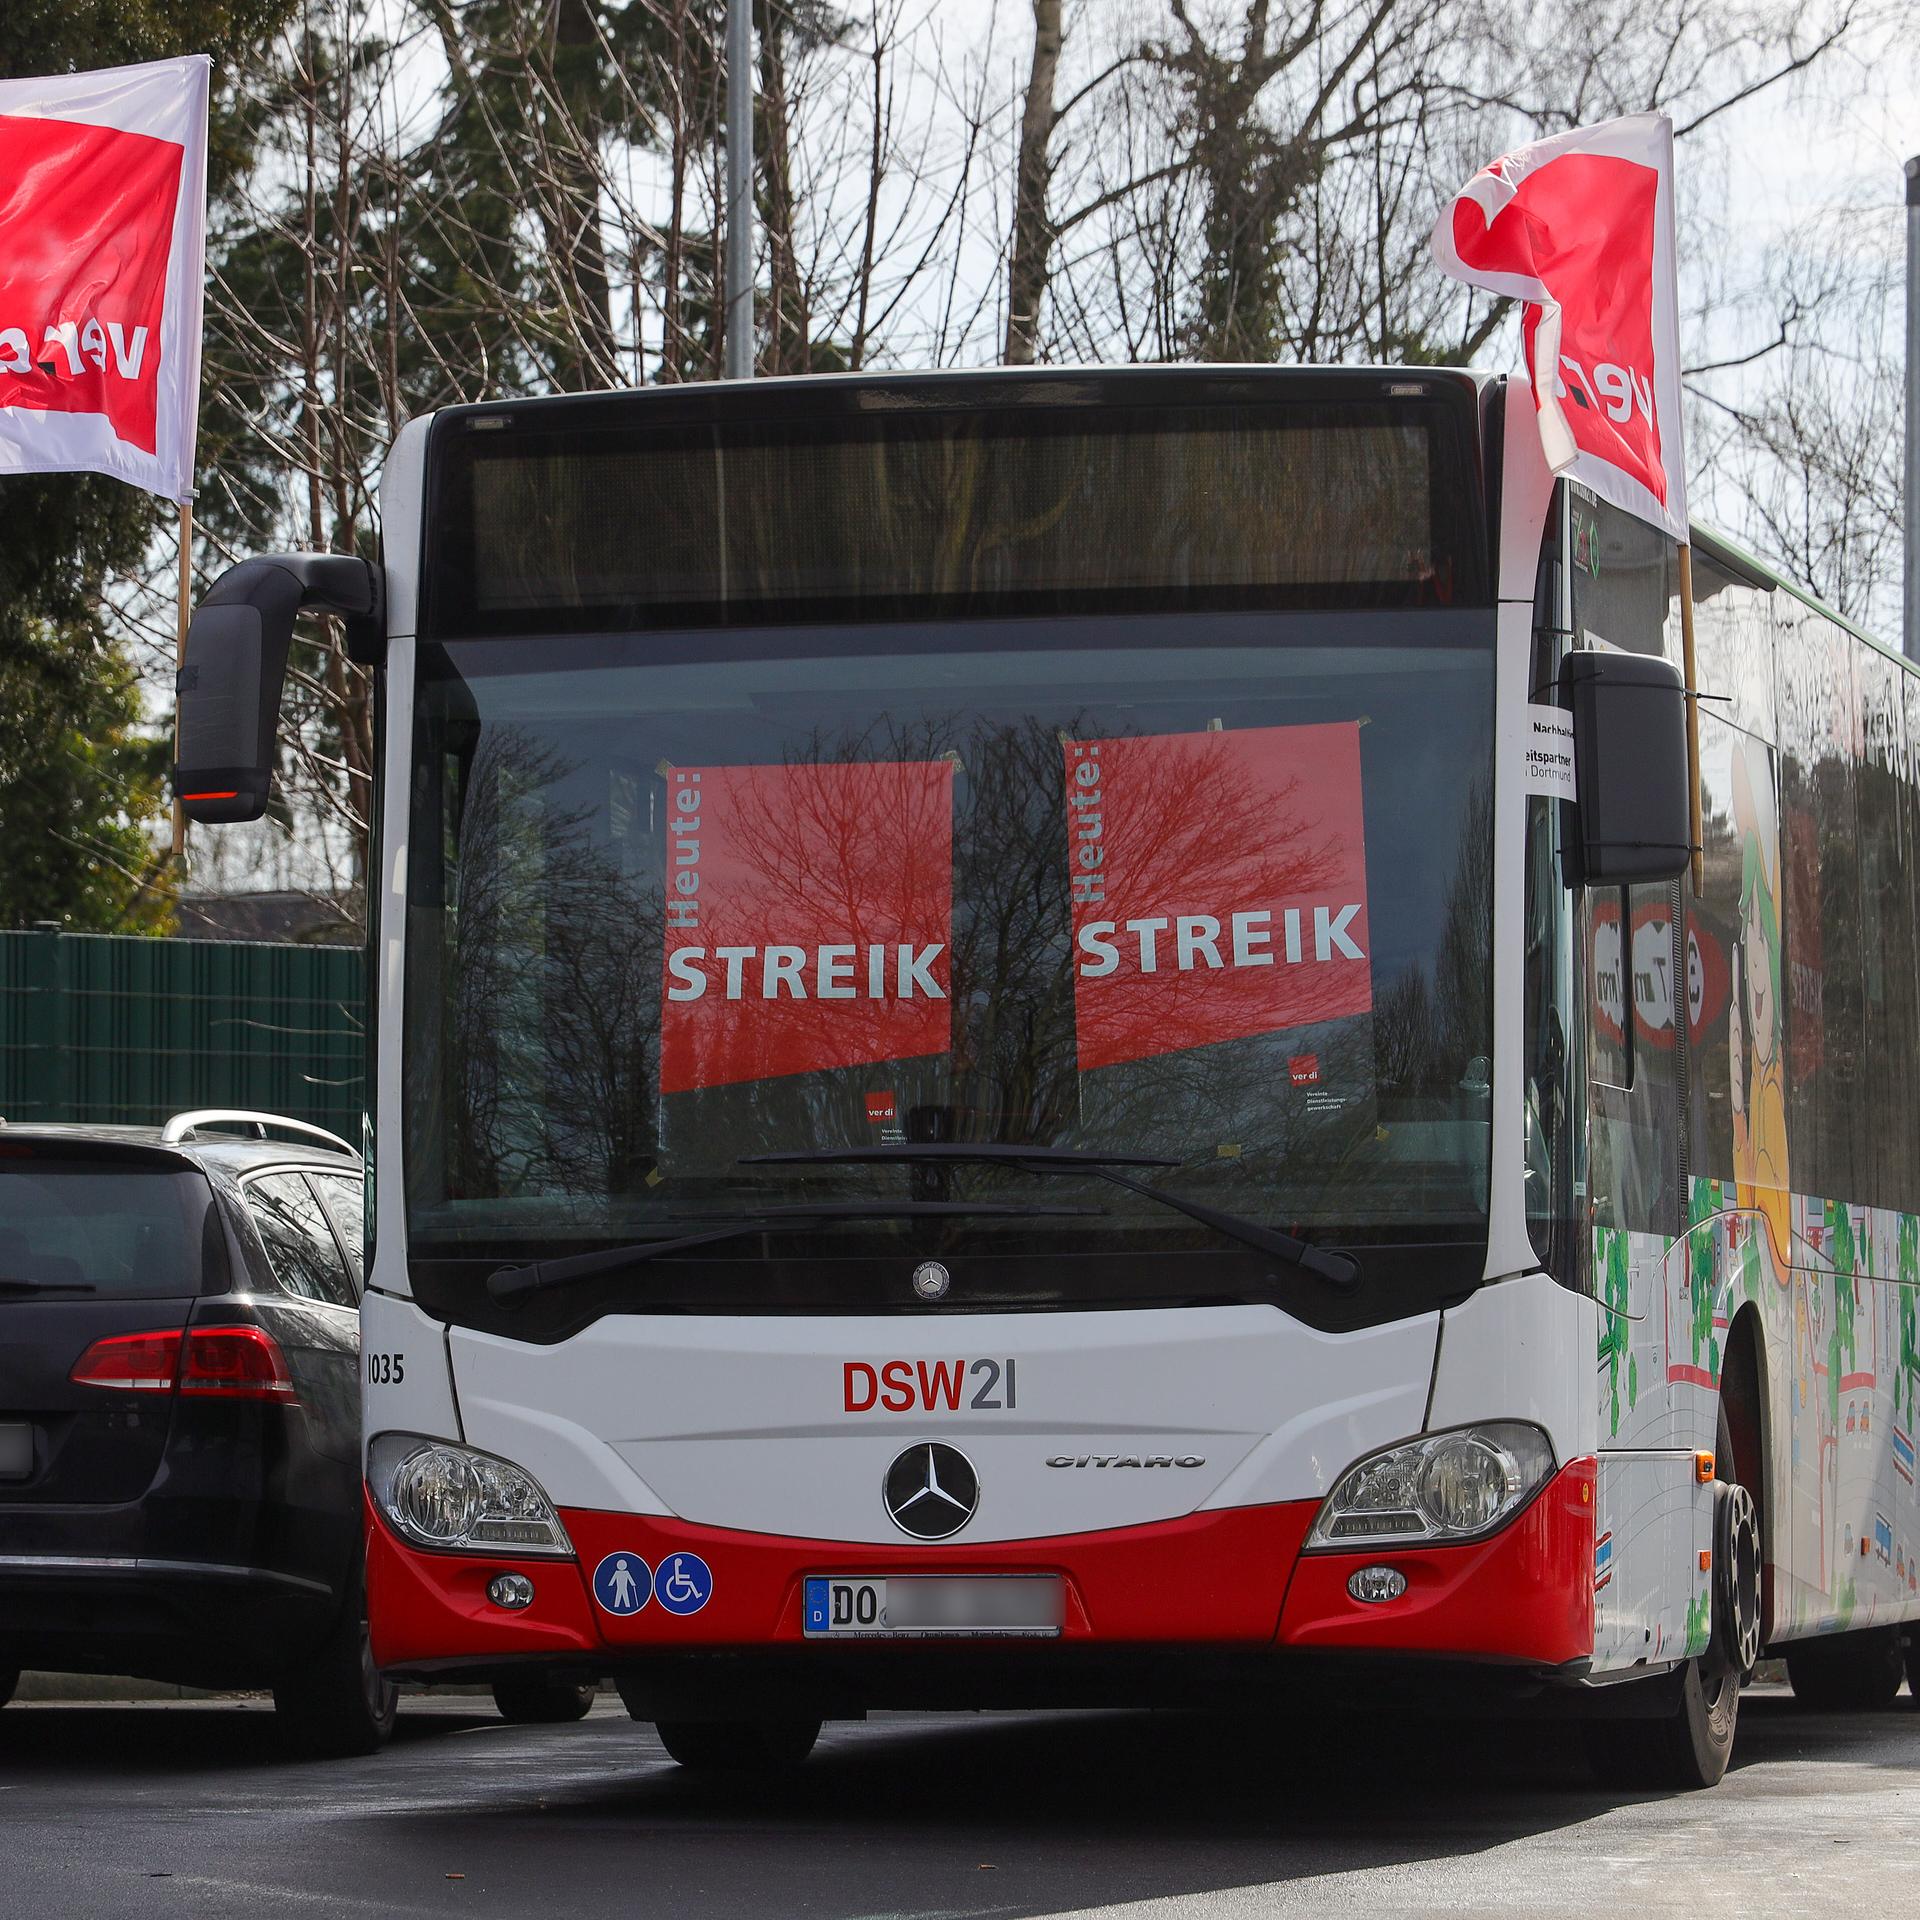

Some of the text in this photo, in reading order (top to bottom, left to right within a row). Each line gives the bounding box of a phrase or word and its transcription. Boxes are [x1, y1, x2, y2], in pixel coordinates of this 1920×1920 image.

[1530, 765, 1571, 782] Dortmund
[668, 772, 702, 929] Heute:
[1071, 746, 1104, 903] Heute:
[1079, 903, 1366, 978] STREIK
[667, 943, 947, 1003] STREIK
[368, 1353, 405, 1385] 1035
[842, 1358, 1017, 1412] DSW21
[1045, 1453, 1206, 1469] CITARO
[813, 1611, 823, 1622] D
[832, 1585, 877, 1625] DO
